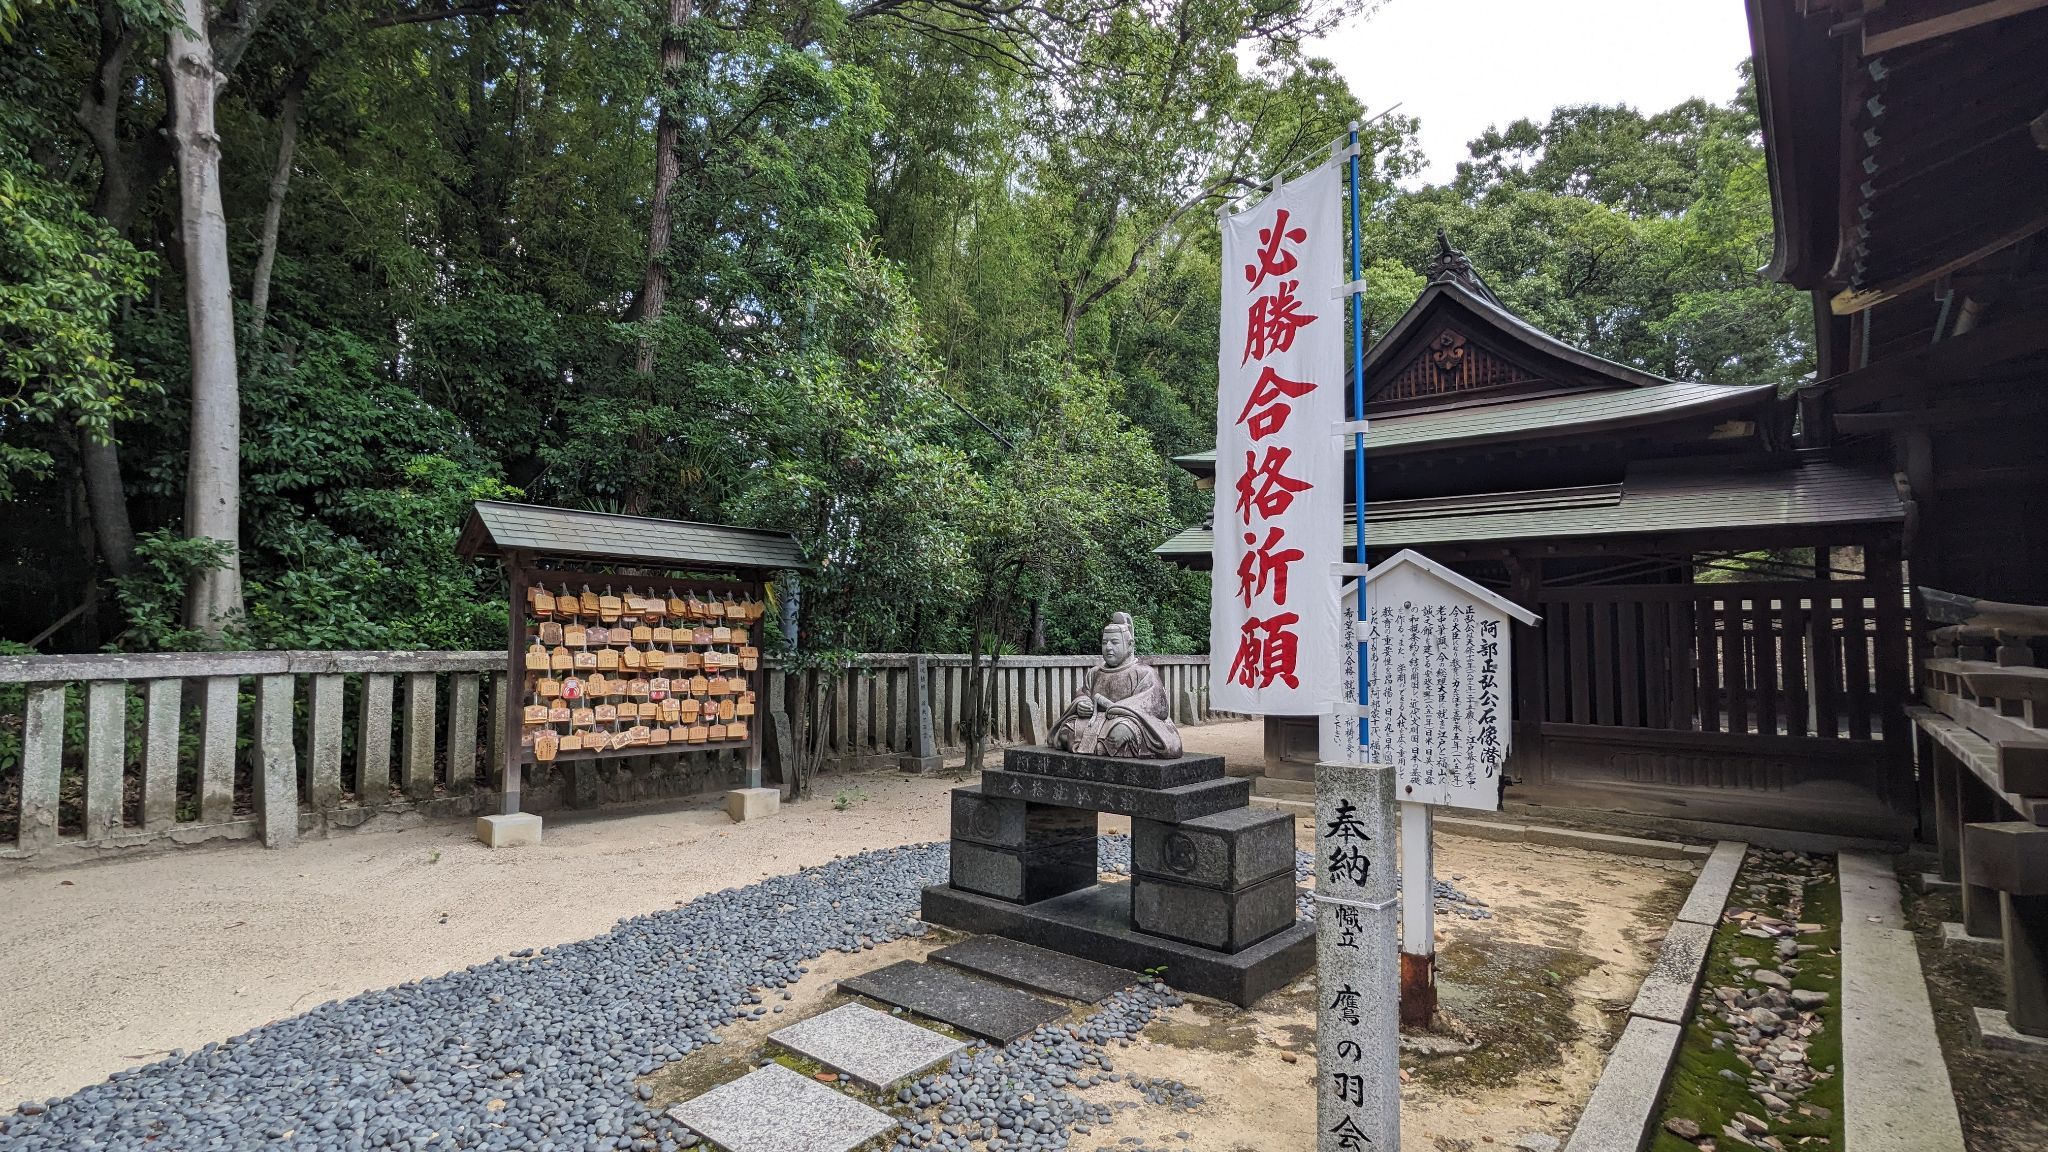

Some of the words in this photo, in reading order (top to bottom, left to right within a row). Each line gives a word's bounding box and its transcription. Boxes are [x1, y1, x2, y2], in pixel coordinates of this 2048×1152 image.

[1226, 208, 1319, 691] 必勝合格祈願
[1477, 619, 1501, 779] 阿部正弘公石像潜り
[1324, 799, 1372, 888] 奉納
[1329, 983, 1373, 1152] 鷹の羽会
